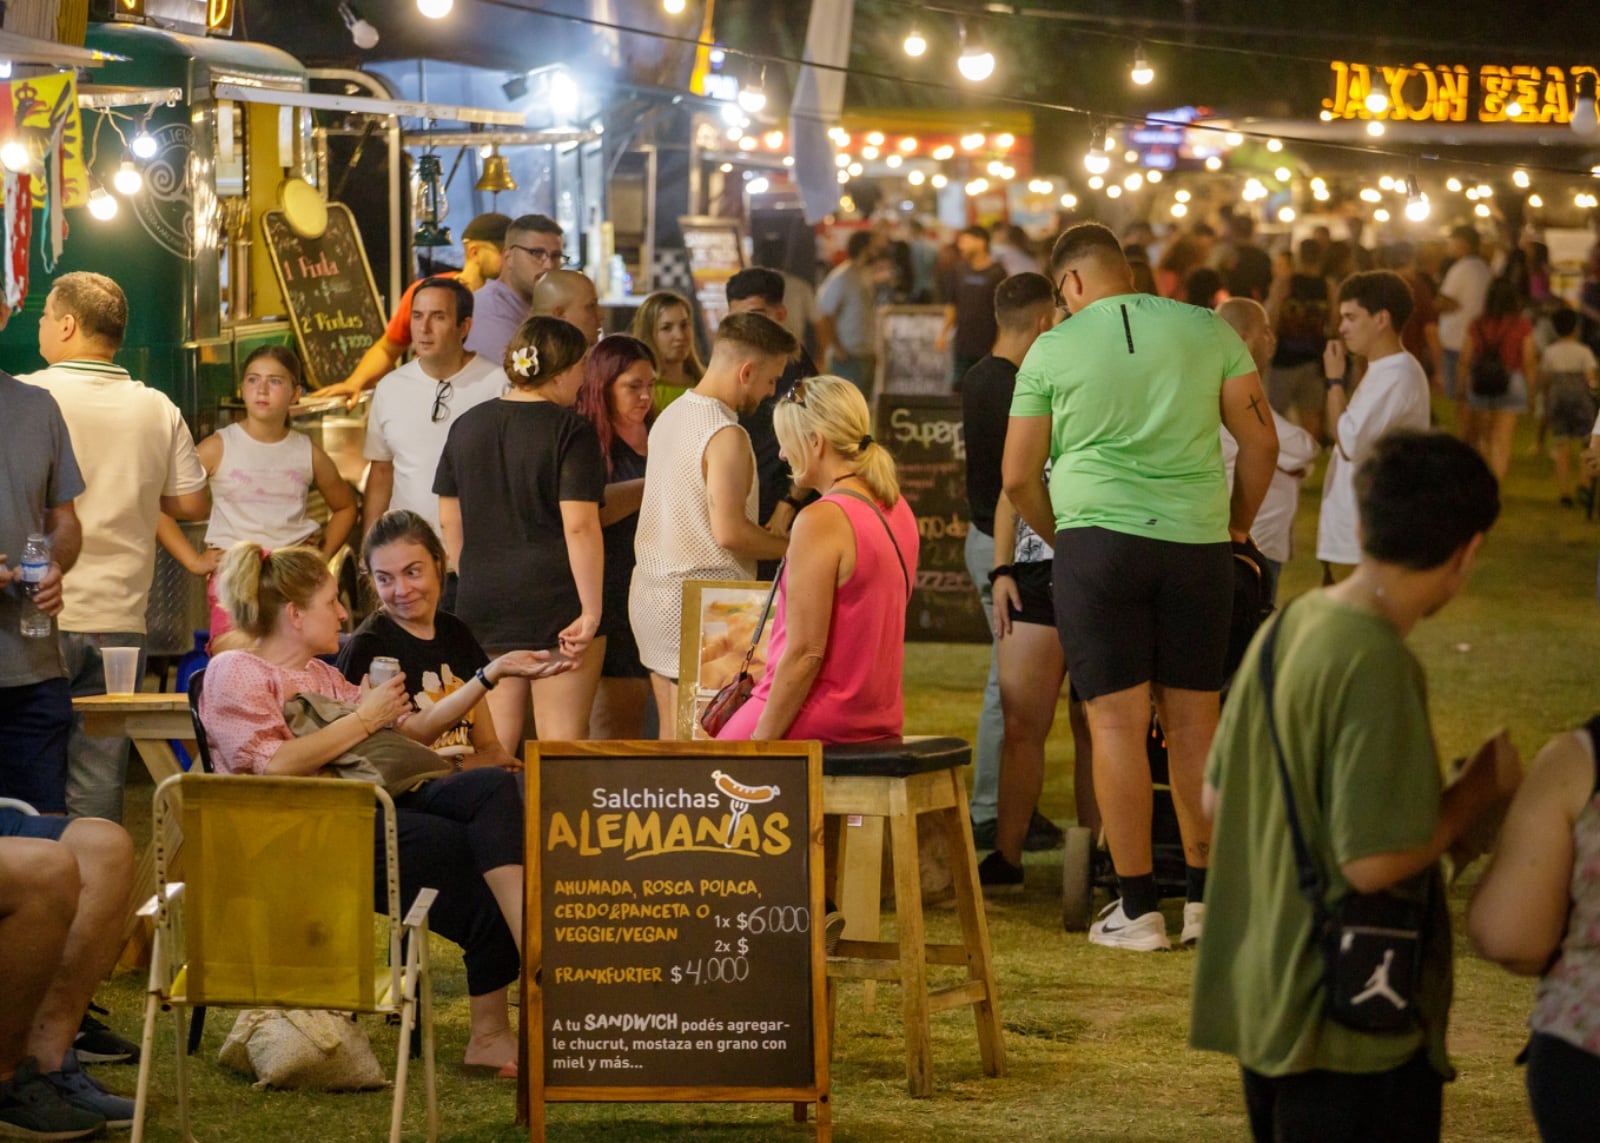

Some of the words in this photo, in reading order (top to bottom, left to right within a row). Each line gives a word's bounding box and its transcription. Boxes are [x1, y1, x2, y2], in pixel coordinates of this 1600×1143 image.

[592, 788, 720, 809] Salchichas
[547, 809, 792, 857] ALEMANAS
[554, 879, 637, 899] AHUMADA,
[643, 880, 694, 896] ROSCA
[701, 879, 762, 898] POLACA,
[554, 903, 690, 920] CERDO&PANCETA
[696, 904, 710, 918] O
[714, 914, 731, 928] 1x
[554, 926, 678, 943] VEGGIE/VEGAN
[714, 939, 731, 953] 2x
[737, 936, 749, 955] $
[555, 966, 663, 984] FRANKFURTER
[552, 1019, 563, 1031] A
[566, 1020, 581, 1032] tu
[583, 1013, 678, 1032] SANDWICH
[681, 1017, 724, 1035] podés
[727, 1021, 791, 1035] agregar-
[552, 1037, 566, 1050] le
[569, 1037, 629, 1052] chucrut,
[632, 1038, 692, 1050] mostaza
[695, 1039, 714, 1050] en
[717, 1039, 759, 1054] grano
[761, 1039, 787, 1050] con
[552, 1055, 585, 1069] miel
[588, 1058, 596, 1071] y
[599, 1055, 643, 1070] más...
